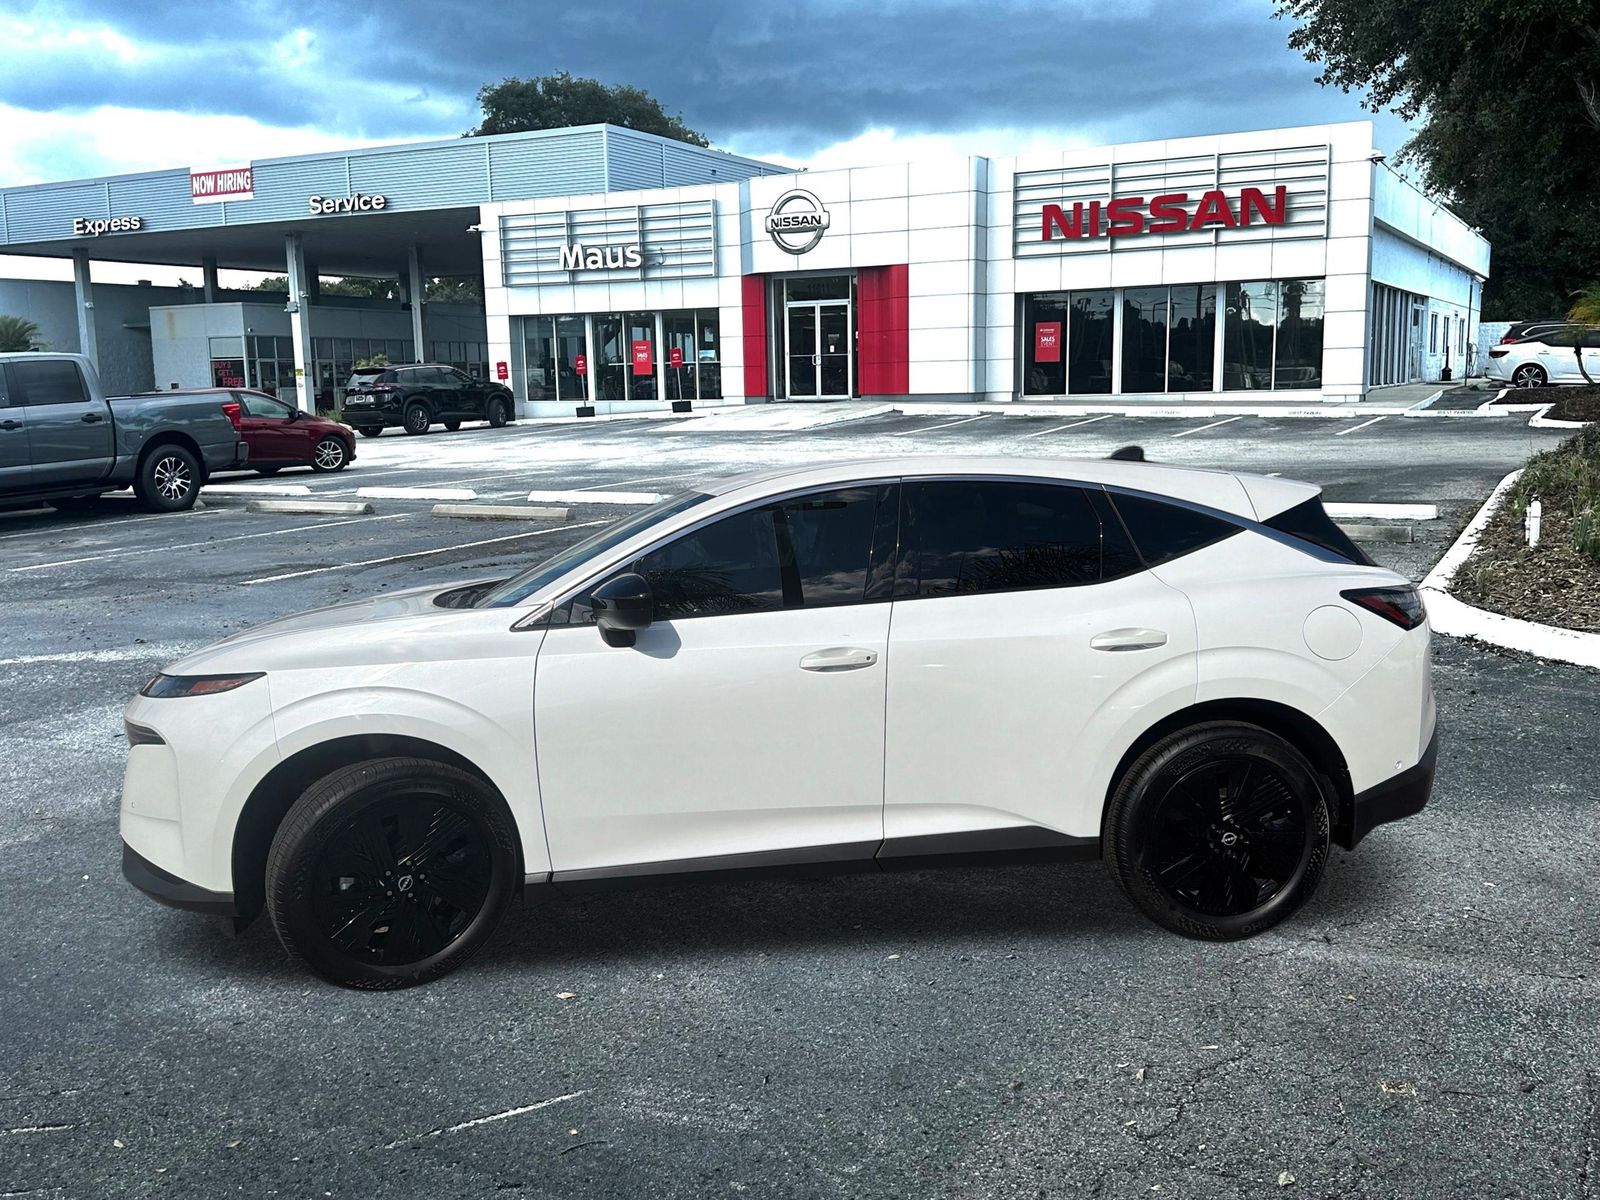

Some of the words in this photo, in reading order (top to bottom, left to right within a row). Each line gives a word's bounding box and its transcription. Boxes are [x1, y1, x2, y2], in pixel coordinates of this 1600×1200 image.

[192, 174, 215, 195] NOW
[217, 171, 251, 192] HIRING
[309, 193, 385, 214] Service
[1042, 185, 1287, 241] NISSAN
[73, 216, 141, 237] Express
[770, 215, 821, 228] NISSAN
[559, 243, 642, 270] Maus
[222, 377, 244, 387] FREE
